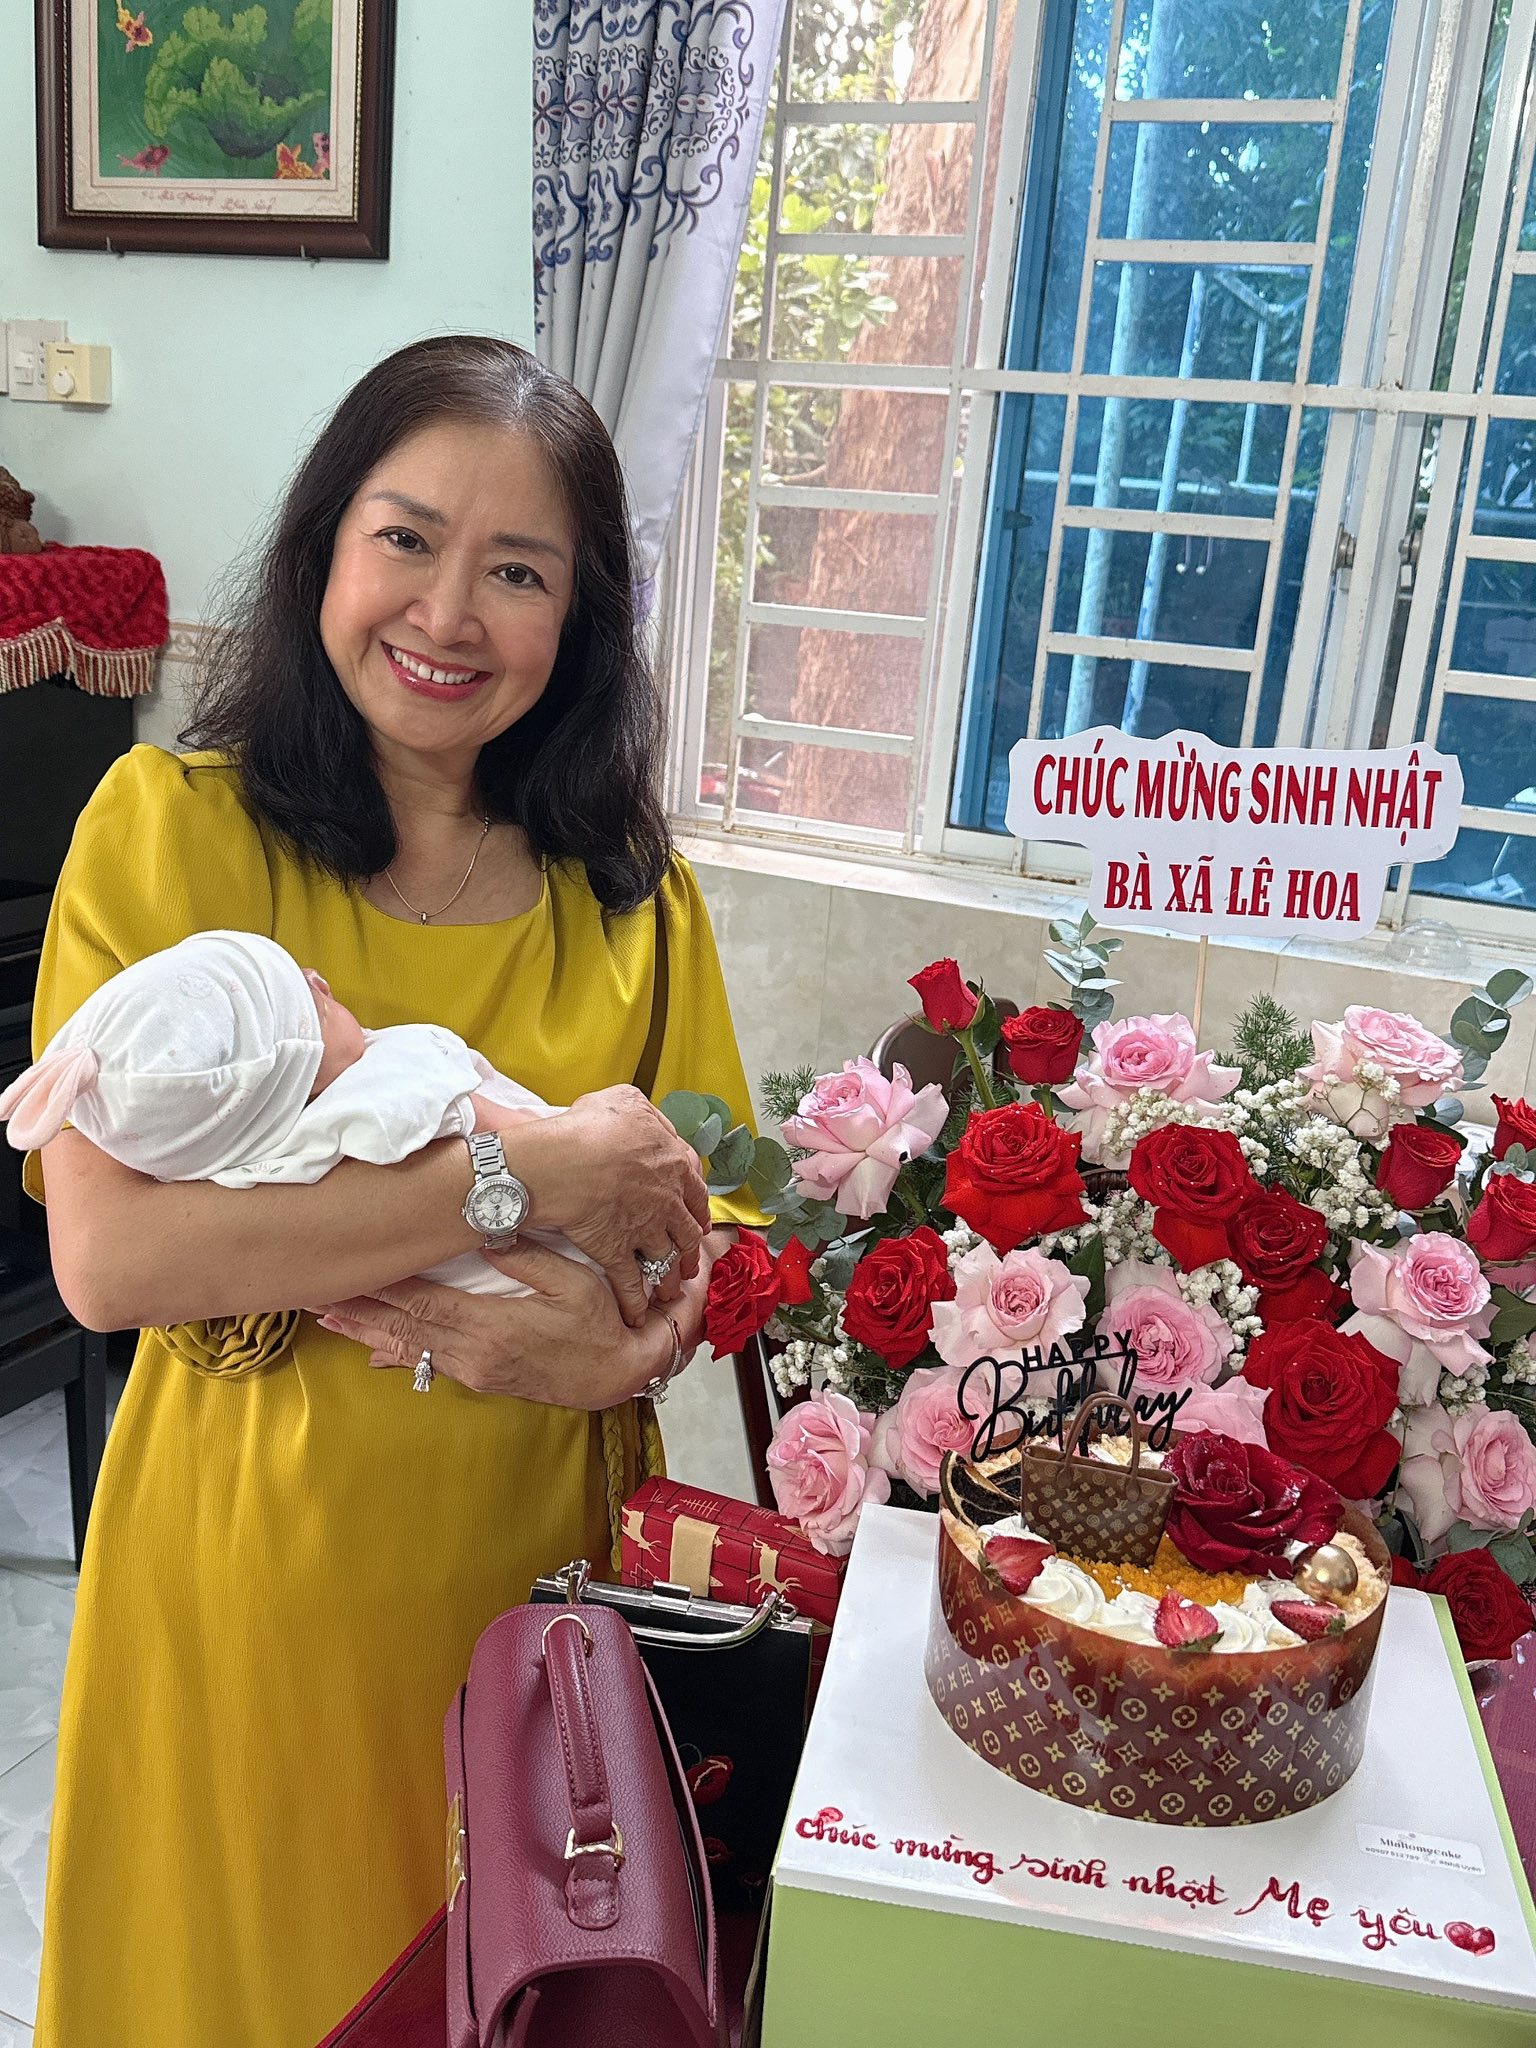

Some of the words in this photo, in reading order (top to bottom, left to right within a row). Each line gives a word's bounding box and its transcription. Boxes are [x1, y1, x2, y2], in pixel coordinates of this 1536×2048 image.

[1034, 738, 1128, 819] CHÚC
[1134, 742, 1241, 823] MỪNG
[1248, 762, 1338, 826] SINH
[1344, 750, 1442, 847] NHẬT
[1103, 852, 1153, 911] BÀ
[1164, 855, 1215, 914] XÃ
[1225, 857, 1273, 917] LÊ
[1283, 870, 1361, 922] HOA
[1022, 1329, 1133, 1371] HAPPY
[1234, 1876, 1335, 1927] Mẹ
